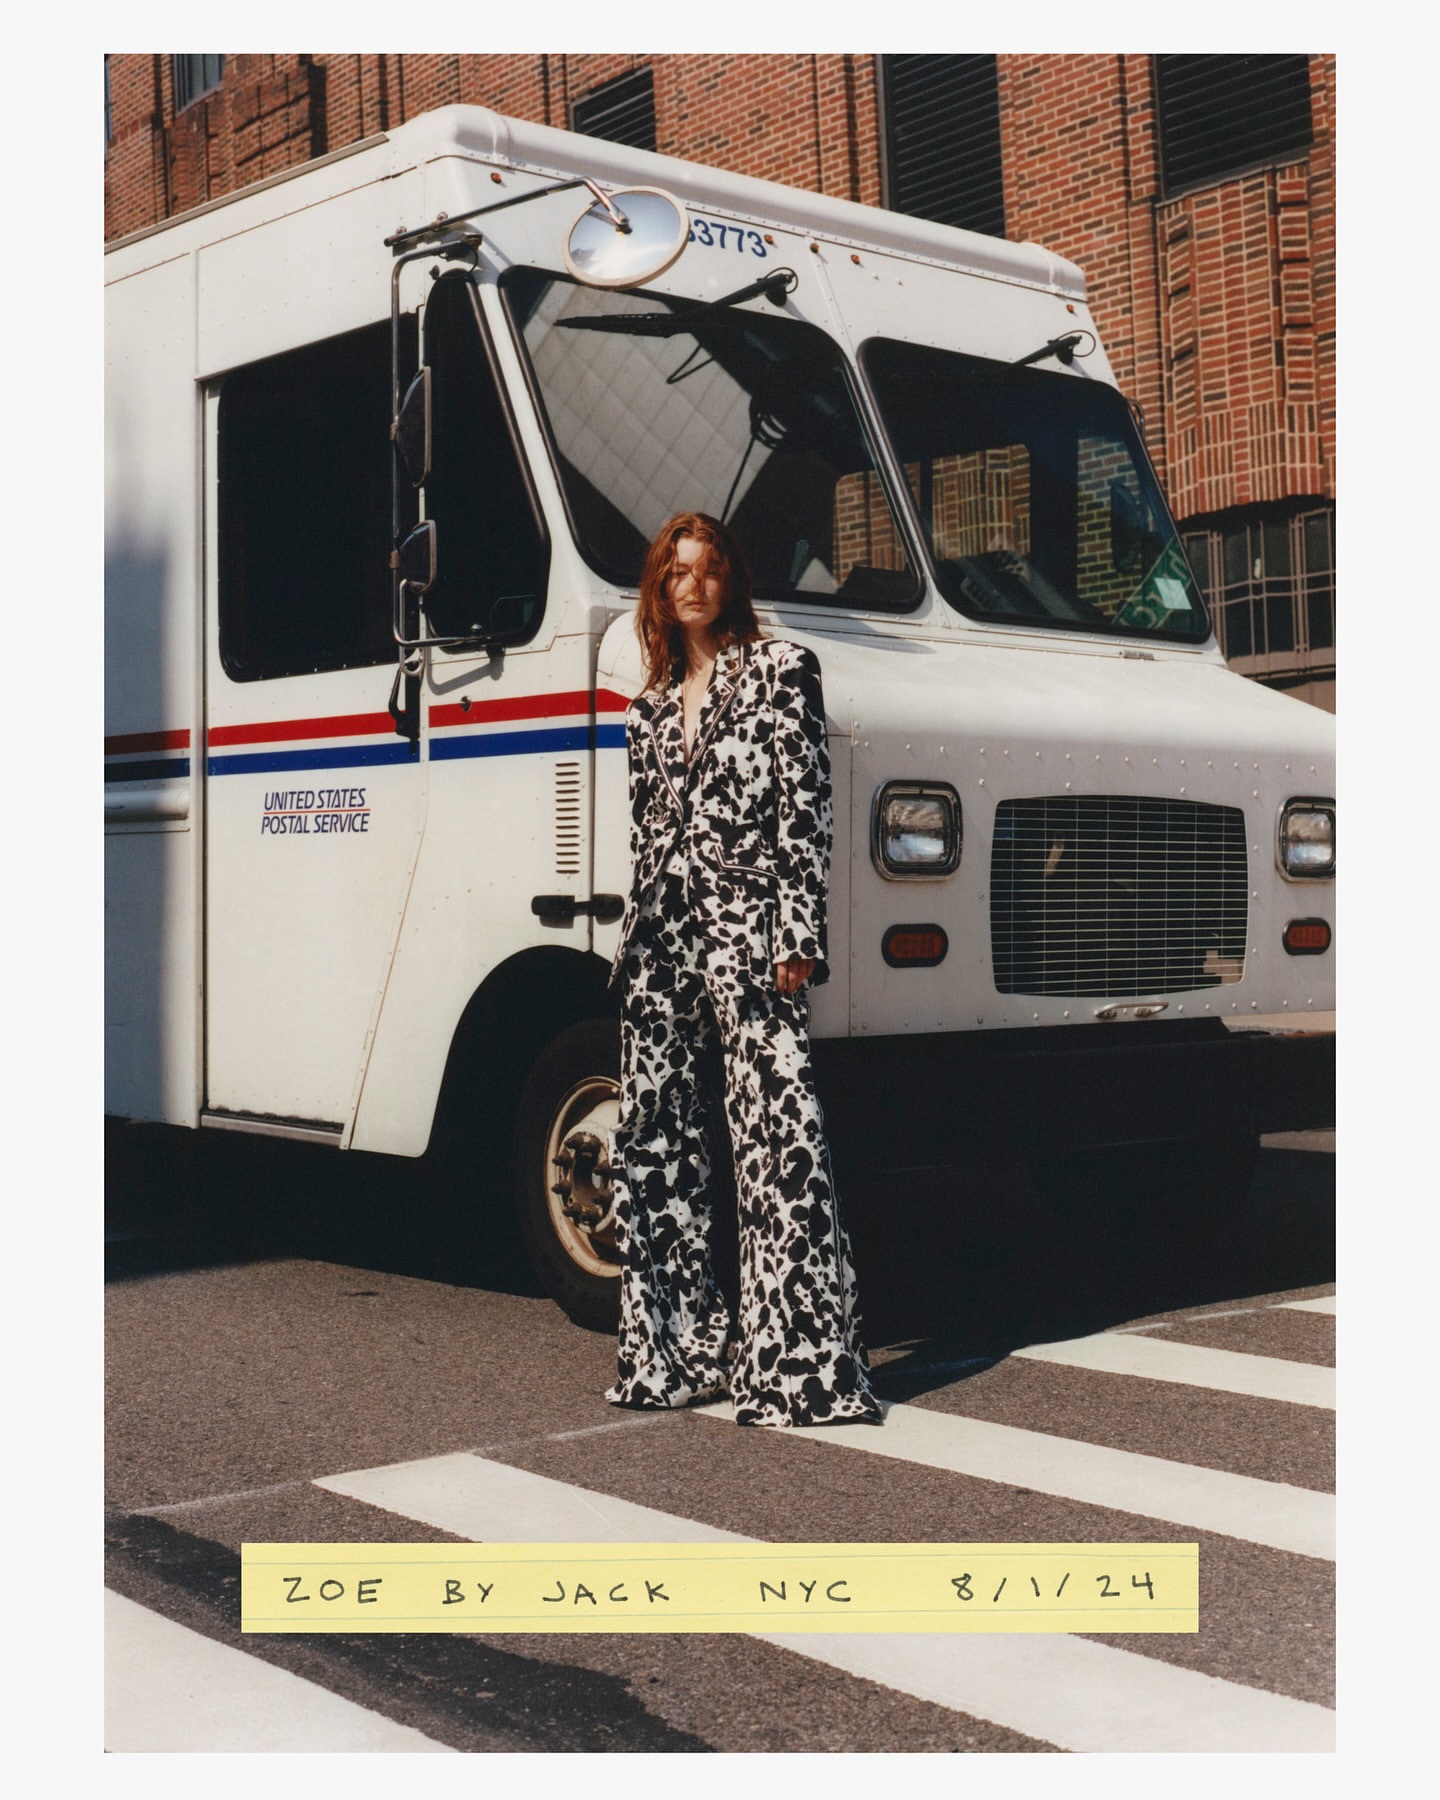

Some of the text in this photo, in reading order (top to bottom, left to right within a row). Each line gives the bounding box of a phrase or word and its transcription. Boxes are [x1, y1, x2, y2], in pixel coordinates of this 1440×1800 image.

[263, 787, 367, 811] UNITED STATES
[261, 812, 371, 835] POSTAL SERVICE
